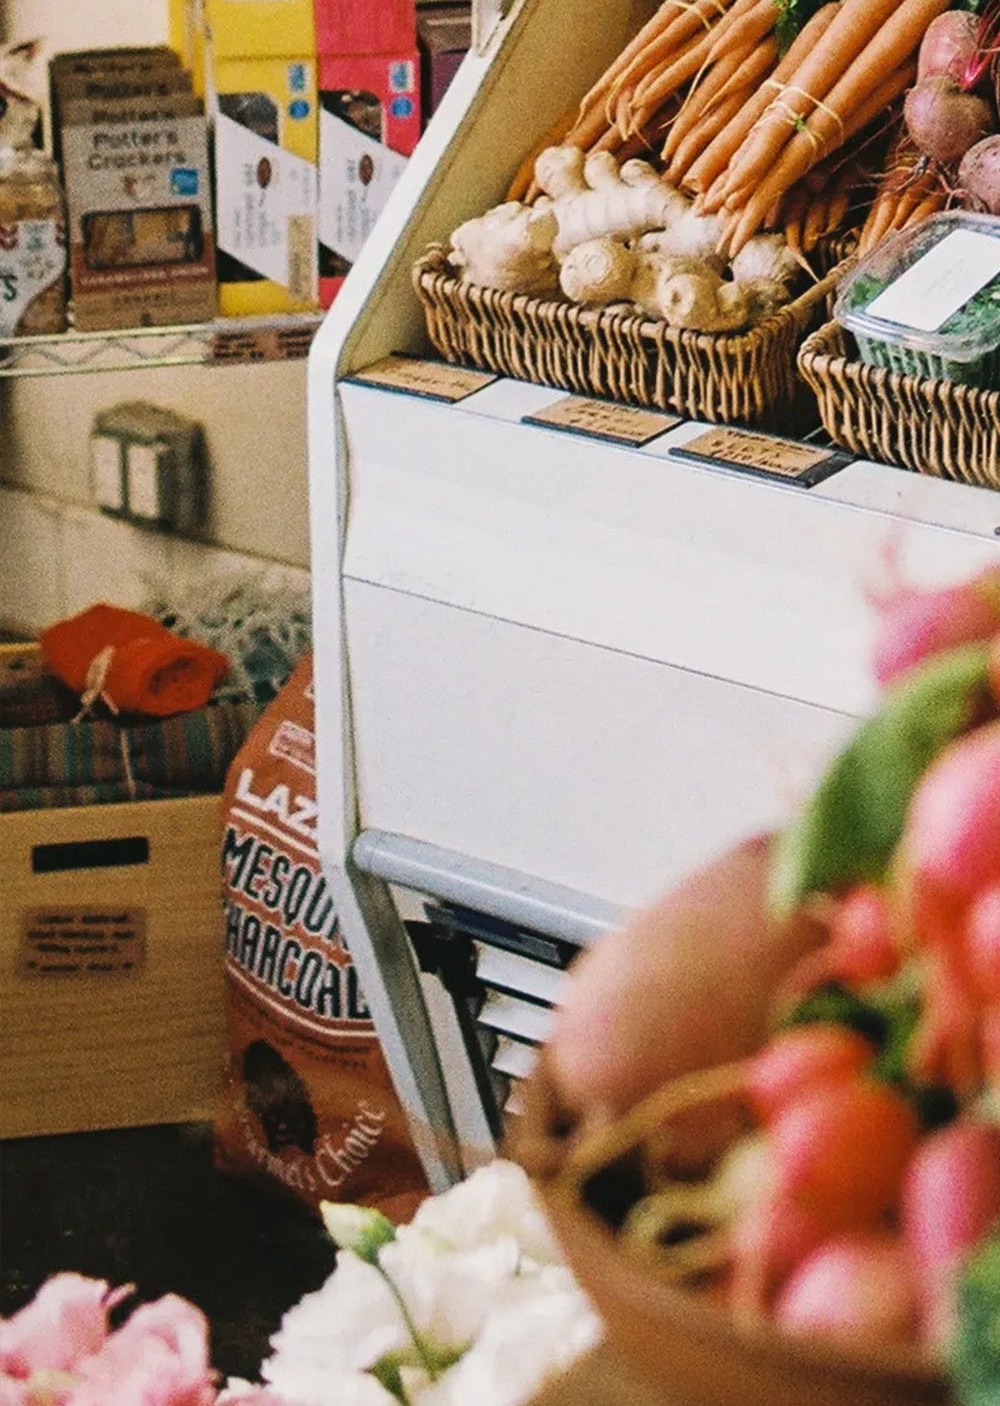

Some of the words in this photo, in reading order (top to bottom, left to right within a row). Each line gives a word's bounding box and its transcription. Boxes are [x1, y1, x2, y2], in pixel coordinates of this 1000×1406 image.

[235, 767, 317, 842] LAZ
[222, 827, 349, 950] MESQU
[225, 902, 372, 1019] HARCOAL
